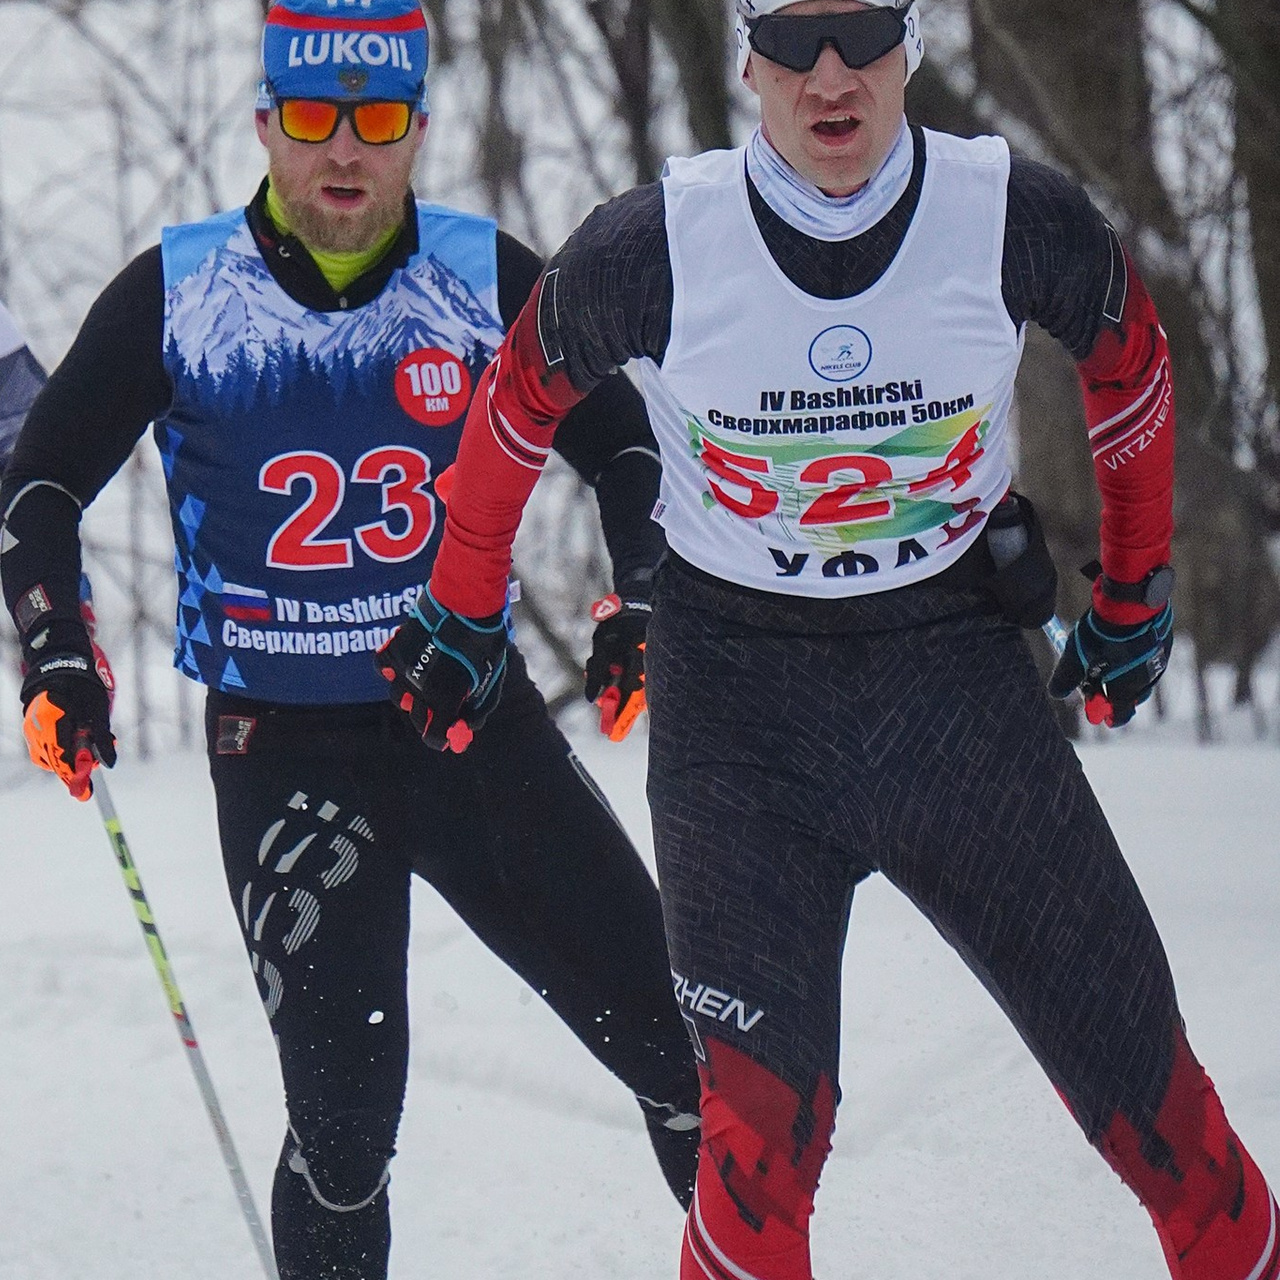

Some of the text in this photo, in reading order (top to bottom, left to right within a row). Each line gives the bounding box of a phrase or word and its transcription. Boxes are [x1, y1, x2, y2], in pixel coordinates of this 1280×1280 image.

[288, 33, 412, 71] LUKOIL
[404, 361, 462, 396] 100
[760, 379, 923, 411] IV BashkirSki
[708, 393, 975, 436] Сверхмарафон 50км
[696, 418, 986, 526] 524
[258, 444, 436, 571] 23
[275, 597, 300, 623] IV
[412, 642, 436, 680] MOAX
